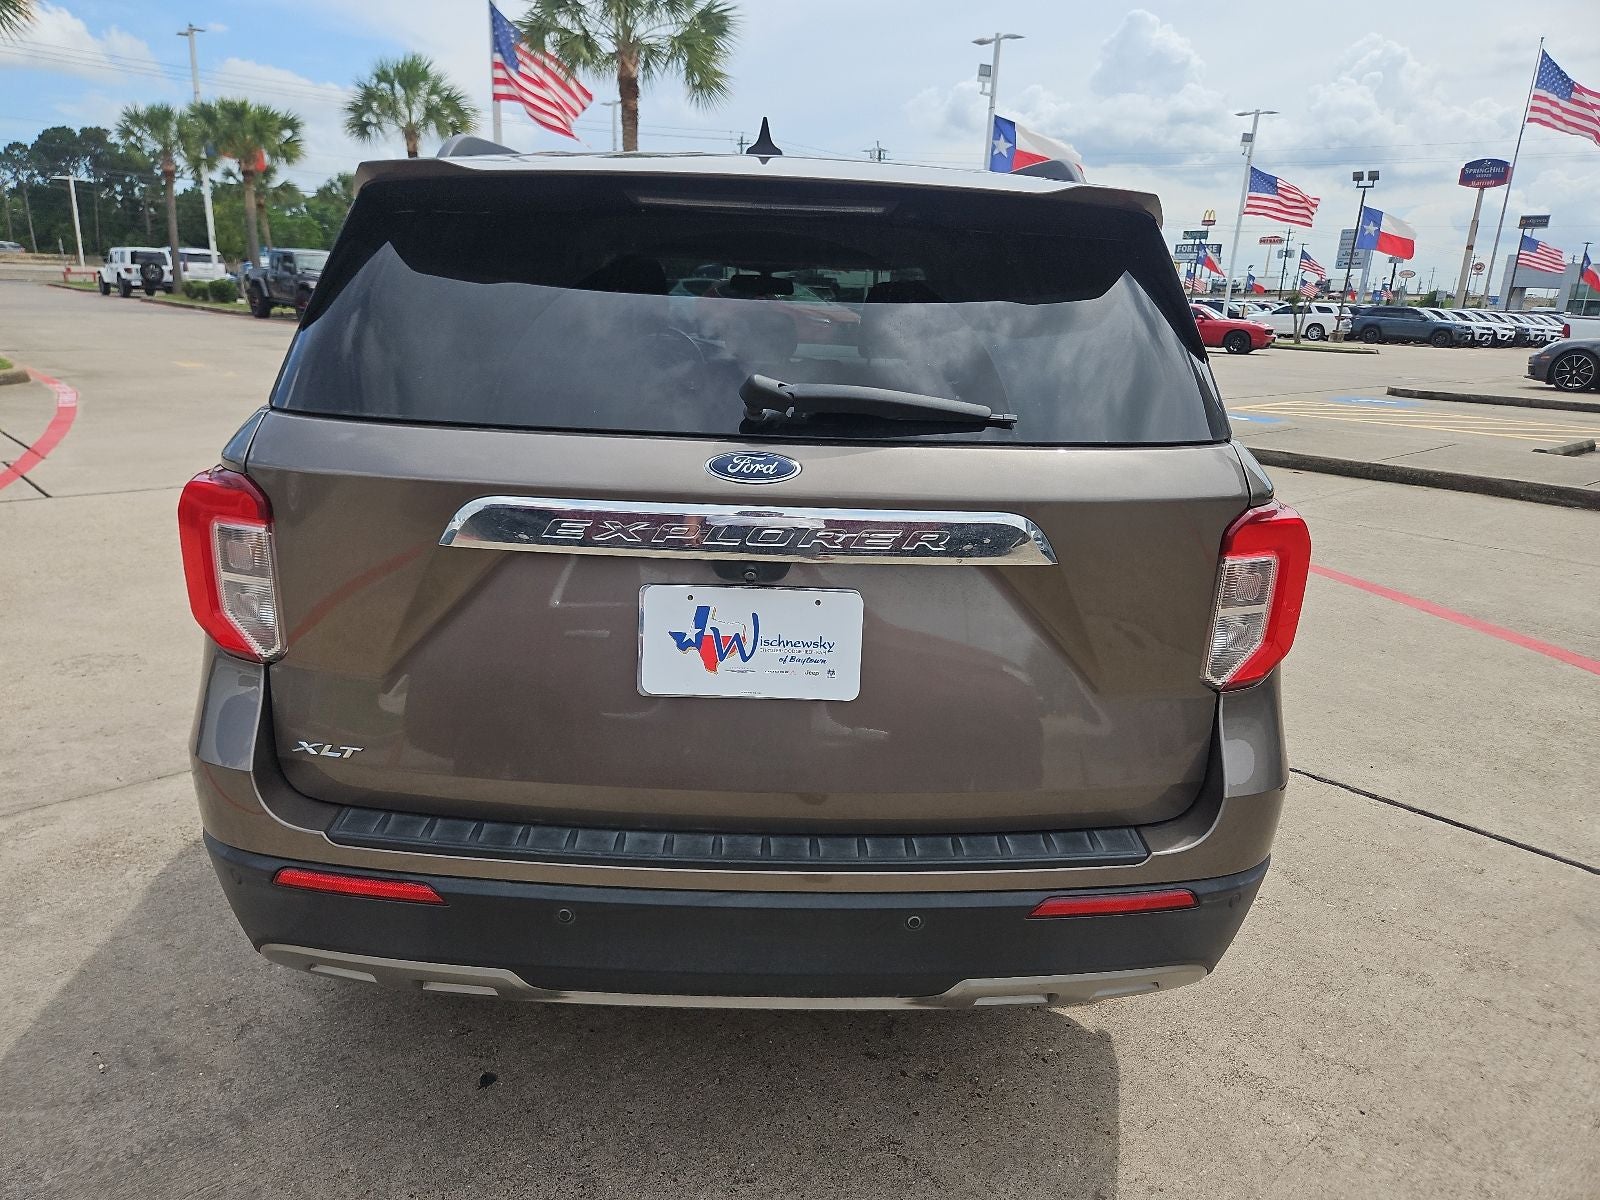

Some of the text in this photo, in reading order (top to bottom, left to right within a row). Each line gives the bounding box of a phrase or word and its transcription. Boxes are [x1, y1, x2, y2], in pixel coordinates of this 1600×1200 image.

[1176, 245, 1193, 253] FOR
[727, 455, 779, 475] Ford
[541, 518, 951, 551] EXPLORER
[778, 655, 828, 665] of Baytown
[291, 740, 364, 759] XLT
